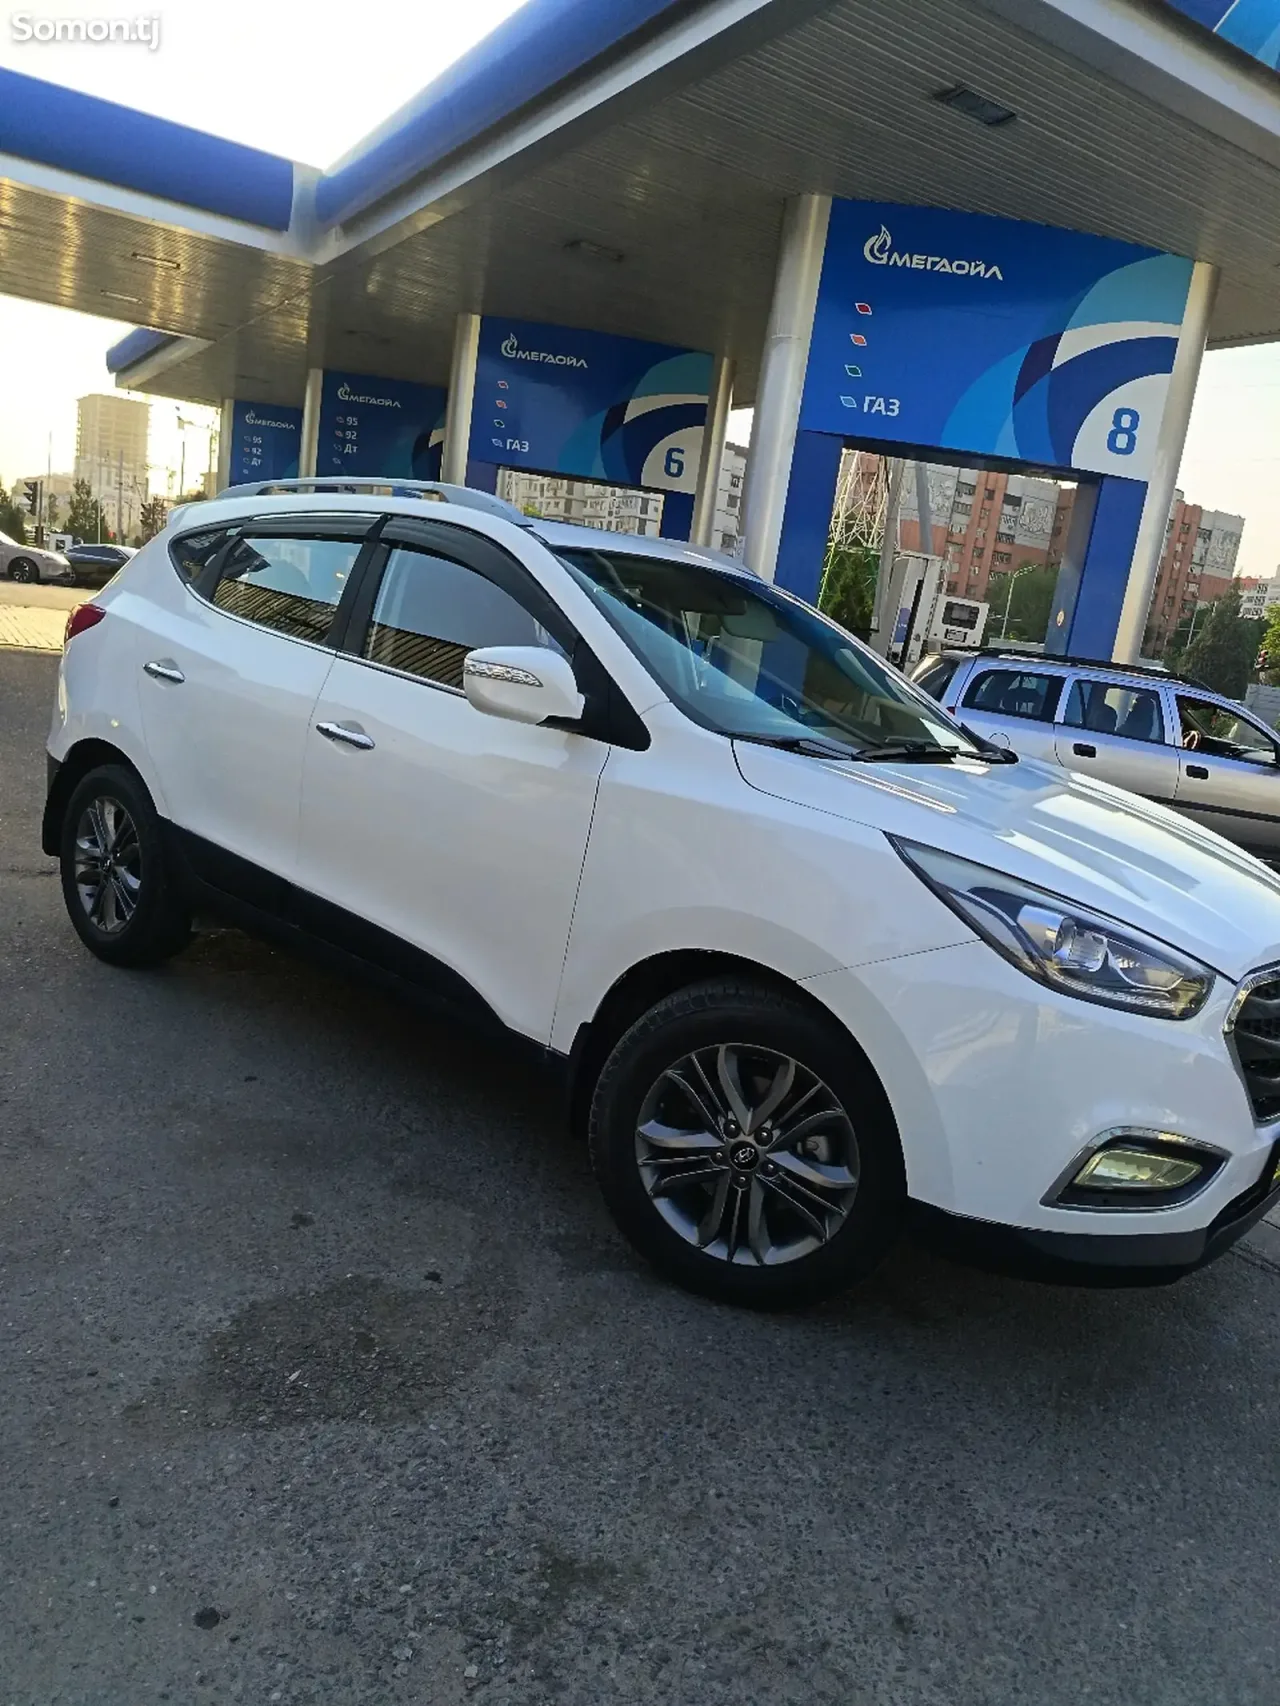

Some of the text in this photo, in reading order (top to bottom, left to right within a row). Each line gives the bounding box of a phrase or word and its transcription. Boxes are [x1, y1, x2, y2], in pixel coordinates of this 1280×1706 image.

[889, 251, 1004, 281] МЕГАОЙЛ
[517, 350, 588, 368] МЕГАОЙЛ
[863, 396, 901, 417] ГАЗ
[346, 416, 358, 426] 95
[252, 435, 262, 444] 95
[345, 430, 357, 440] 92
[1106, 407, 1140, 455] 8
[506, 438, 530, 453] ГАЗ
[664, 447, 685, 478] 6
